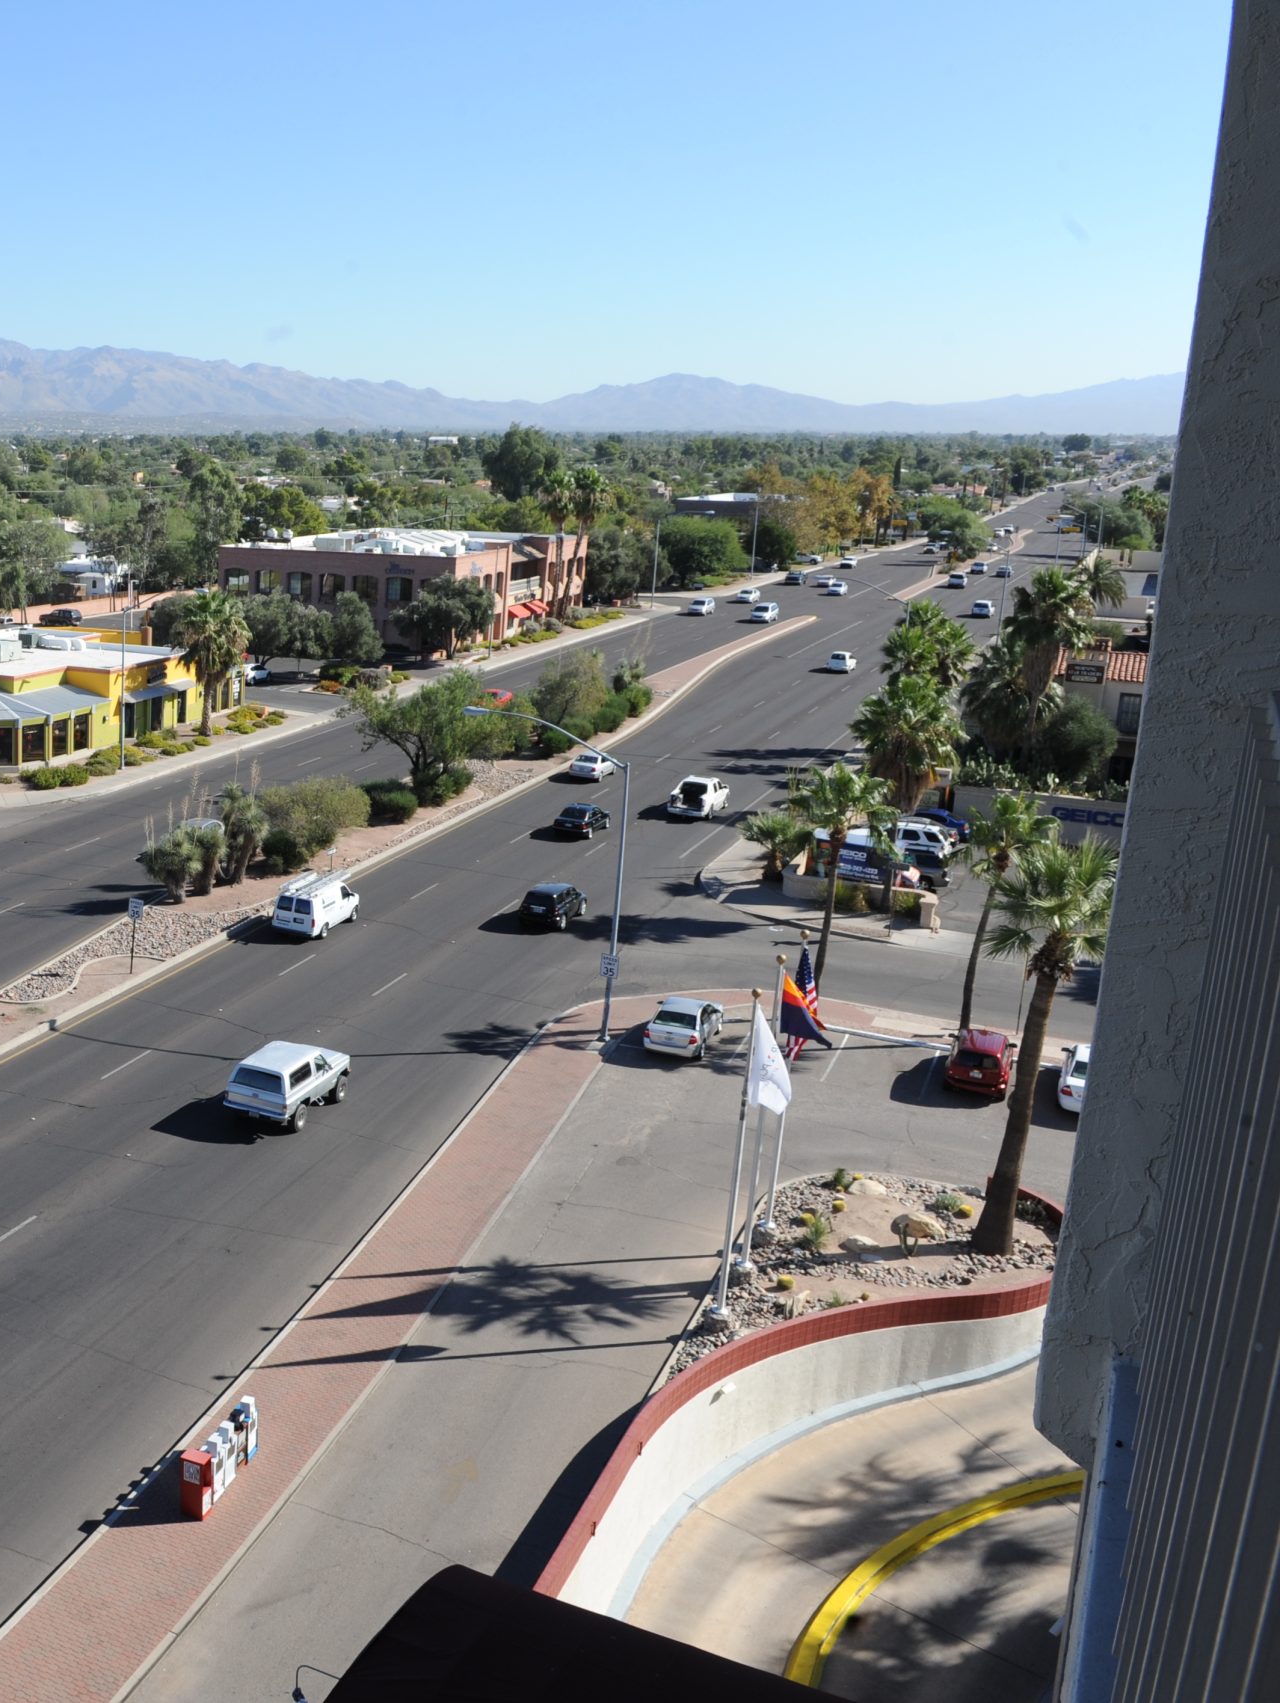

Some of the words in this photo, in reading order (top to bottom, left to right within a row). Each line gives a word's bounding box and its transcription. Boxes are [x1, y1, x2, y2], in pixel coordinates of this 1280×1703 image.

[1051, 806, 1125, 827] GEICO
[130, 909, 141, 919] 35
[602, 966, 615, 977] 35
